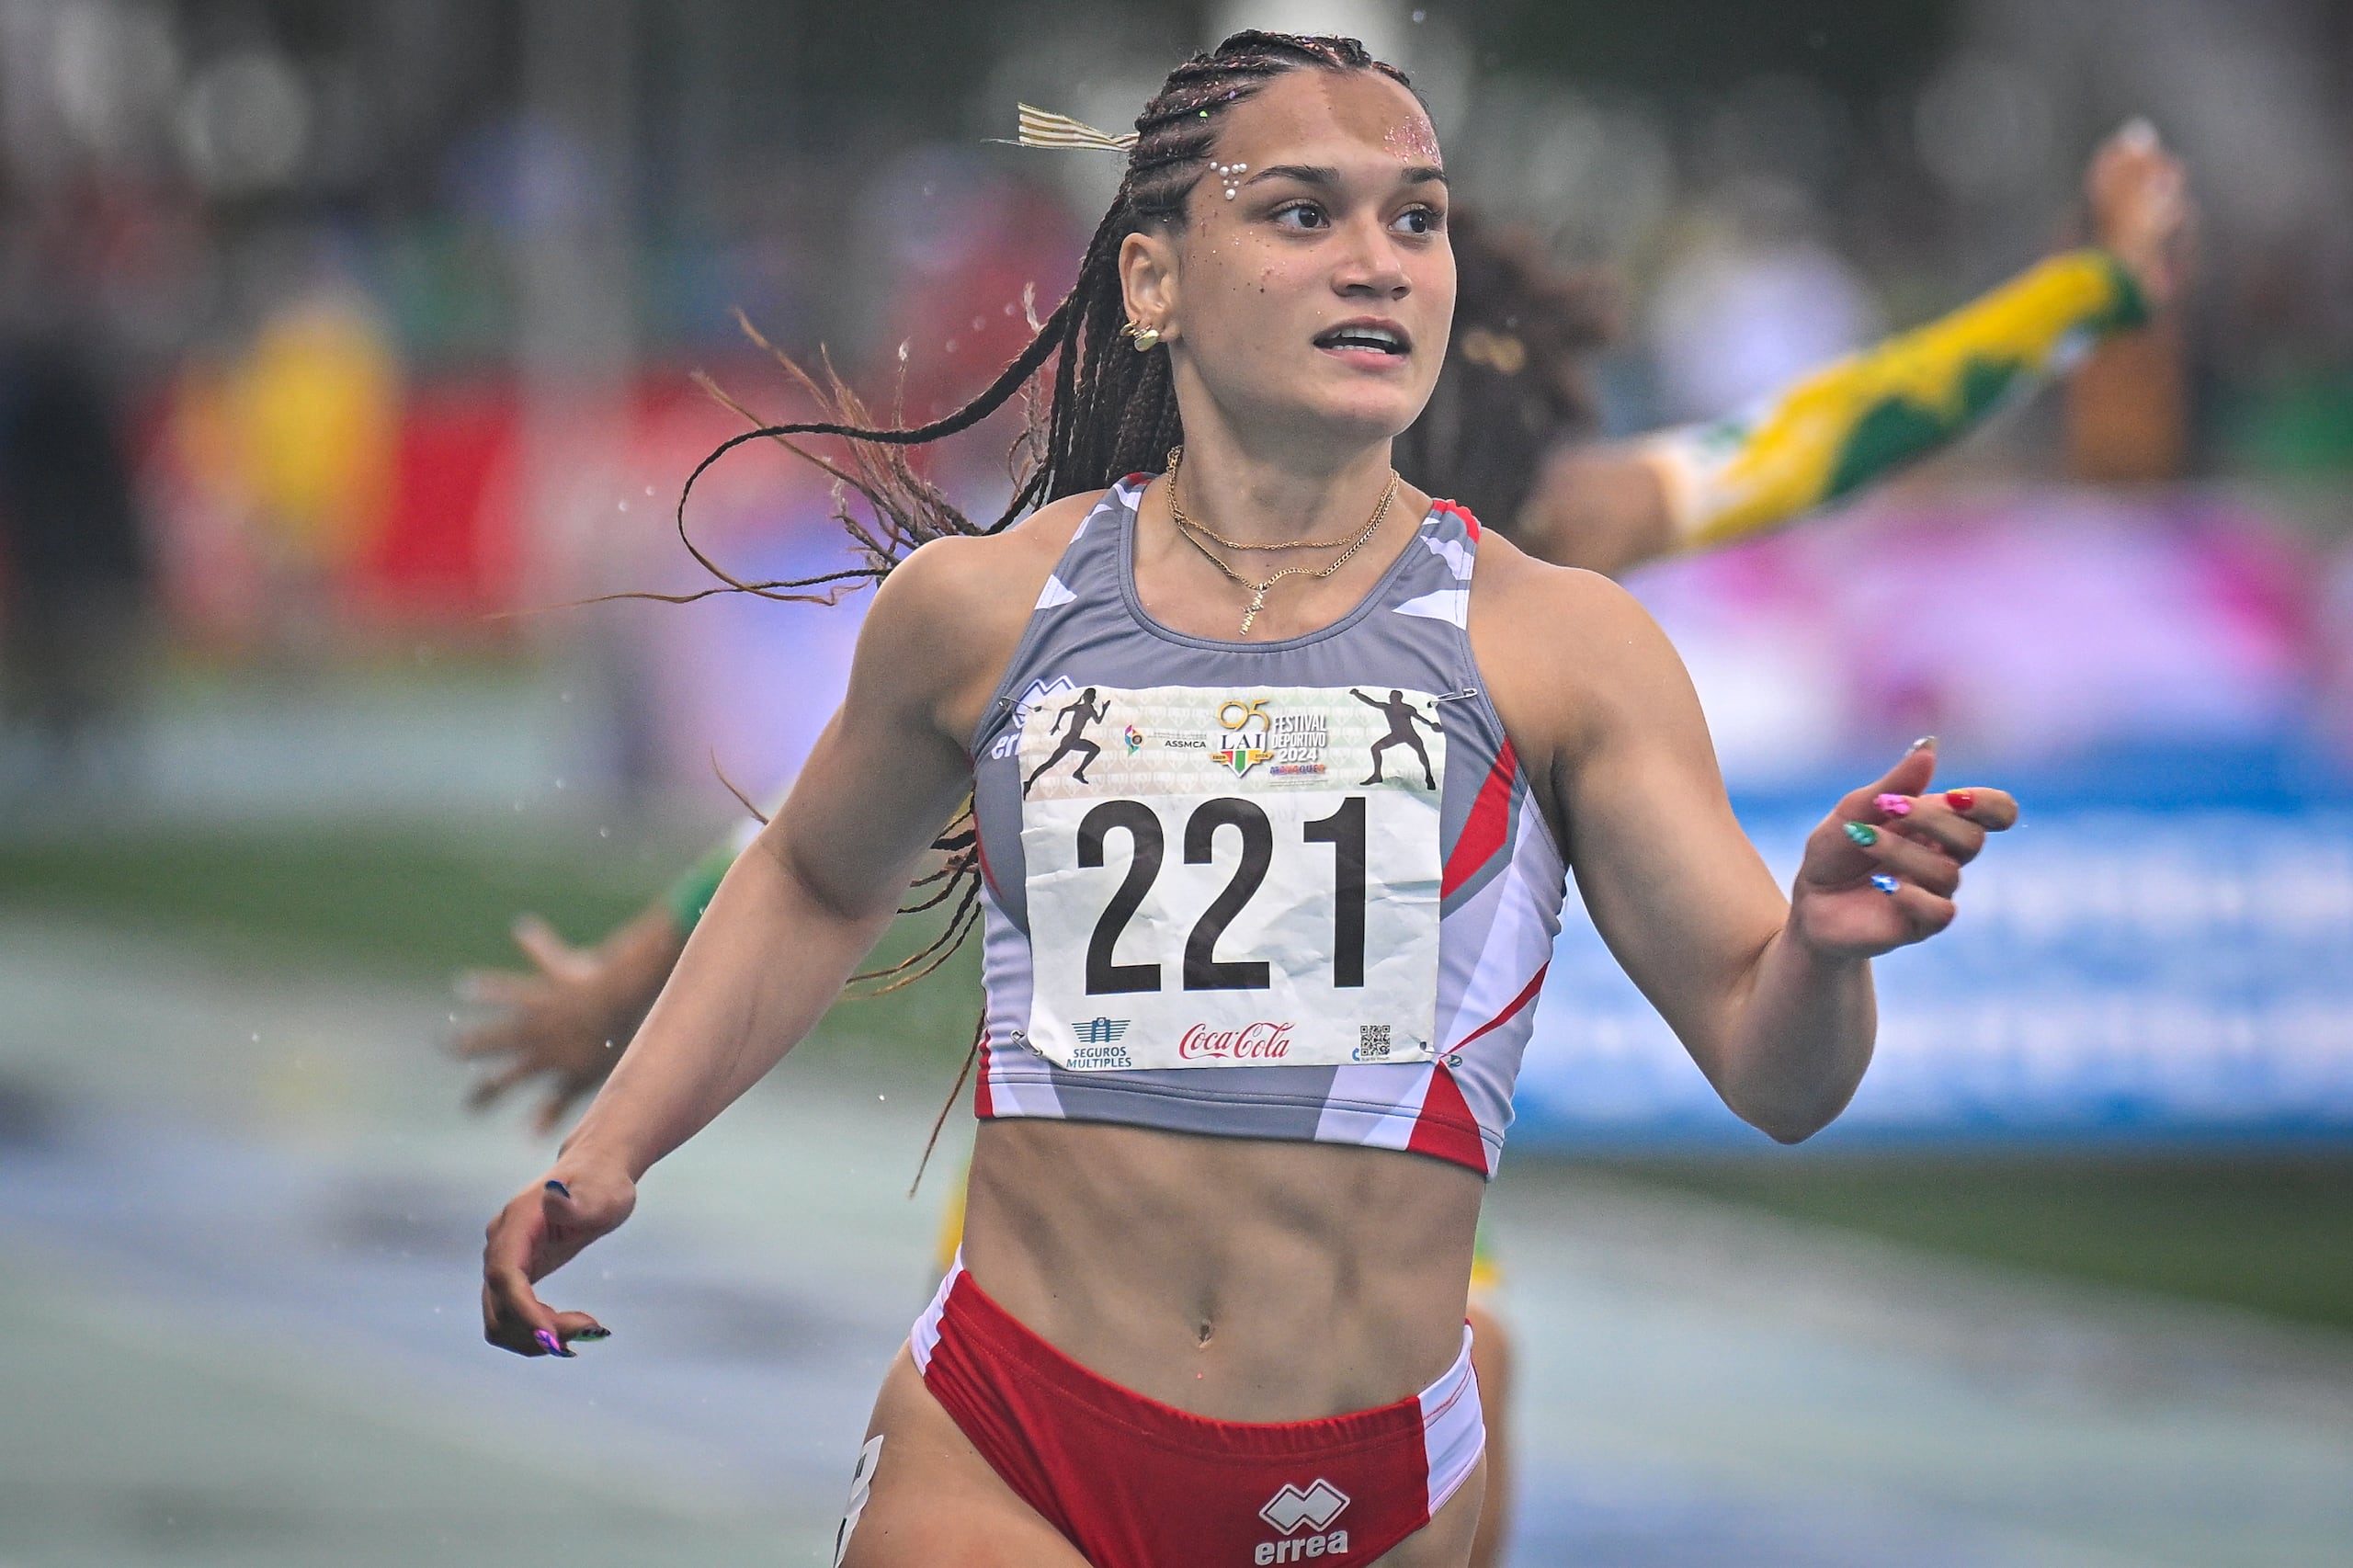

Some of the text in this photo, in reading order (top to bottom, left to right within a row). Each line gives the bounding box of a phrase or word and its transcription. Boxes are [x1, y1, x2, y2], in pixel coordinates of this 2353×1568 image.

[1217, 699, 1271, 732] 95
[1273, 714, 1327, 734] FESTIVAL
[1165, 740, 1207, 748] ASSMCA
[1221, 733, 1263, 750] LAI
[1272, 733, 1327, 749] DEPORTIVO
[1279, 747, 1319, 764] 2024
[1077, 797, 1367, 995] 221
[1179, 1022, 1296, 1059] Coca-Cola
[1073, 1046, 1127, 1058] SEGUROS
[1065, 1057, 1132, 1069] MULTIPLES
[1255, 1530, 1348, 1566] errea
